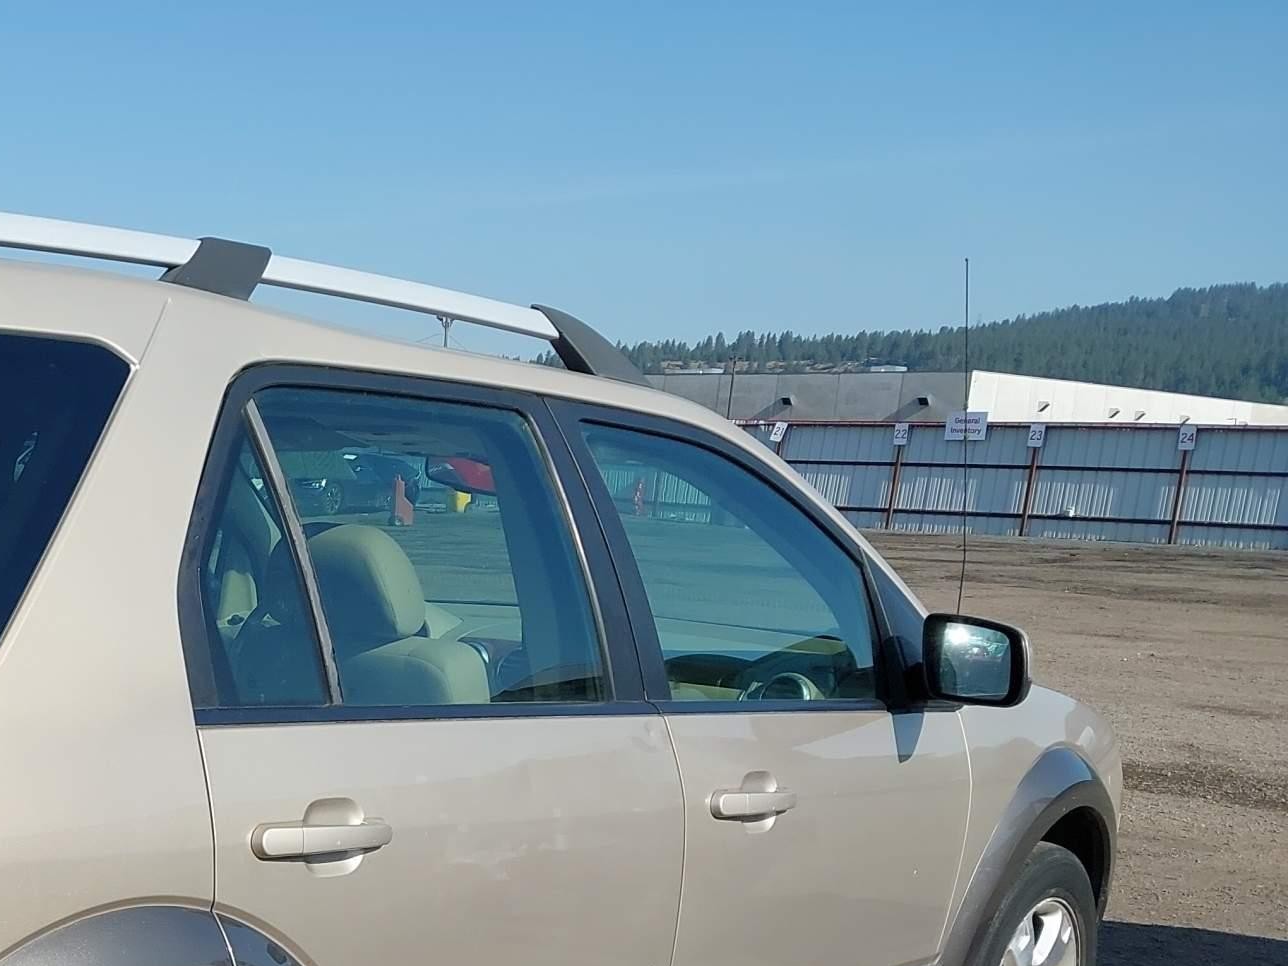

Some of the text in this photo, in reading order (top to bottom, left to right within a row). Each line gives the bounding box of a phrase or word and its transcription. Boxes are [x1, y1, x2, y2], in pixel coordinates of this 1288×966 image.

[773, 426, 785, 437] 21
[894, 428, 907, 440] 22
[1029, 430, 1043, 441] 23
[1180, 432, 1195, 444] 24
